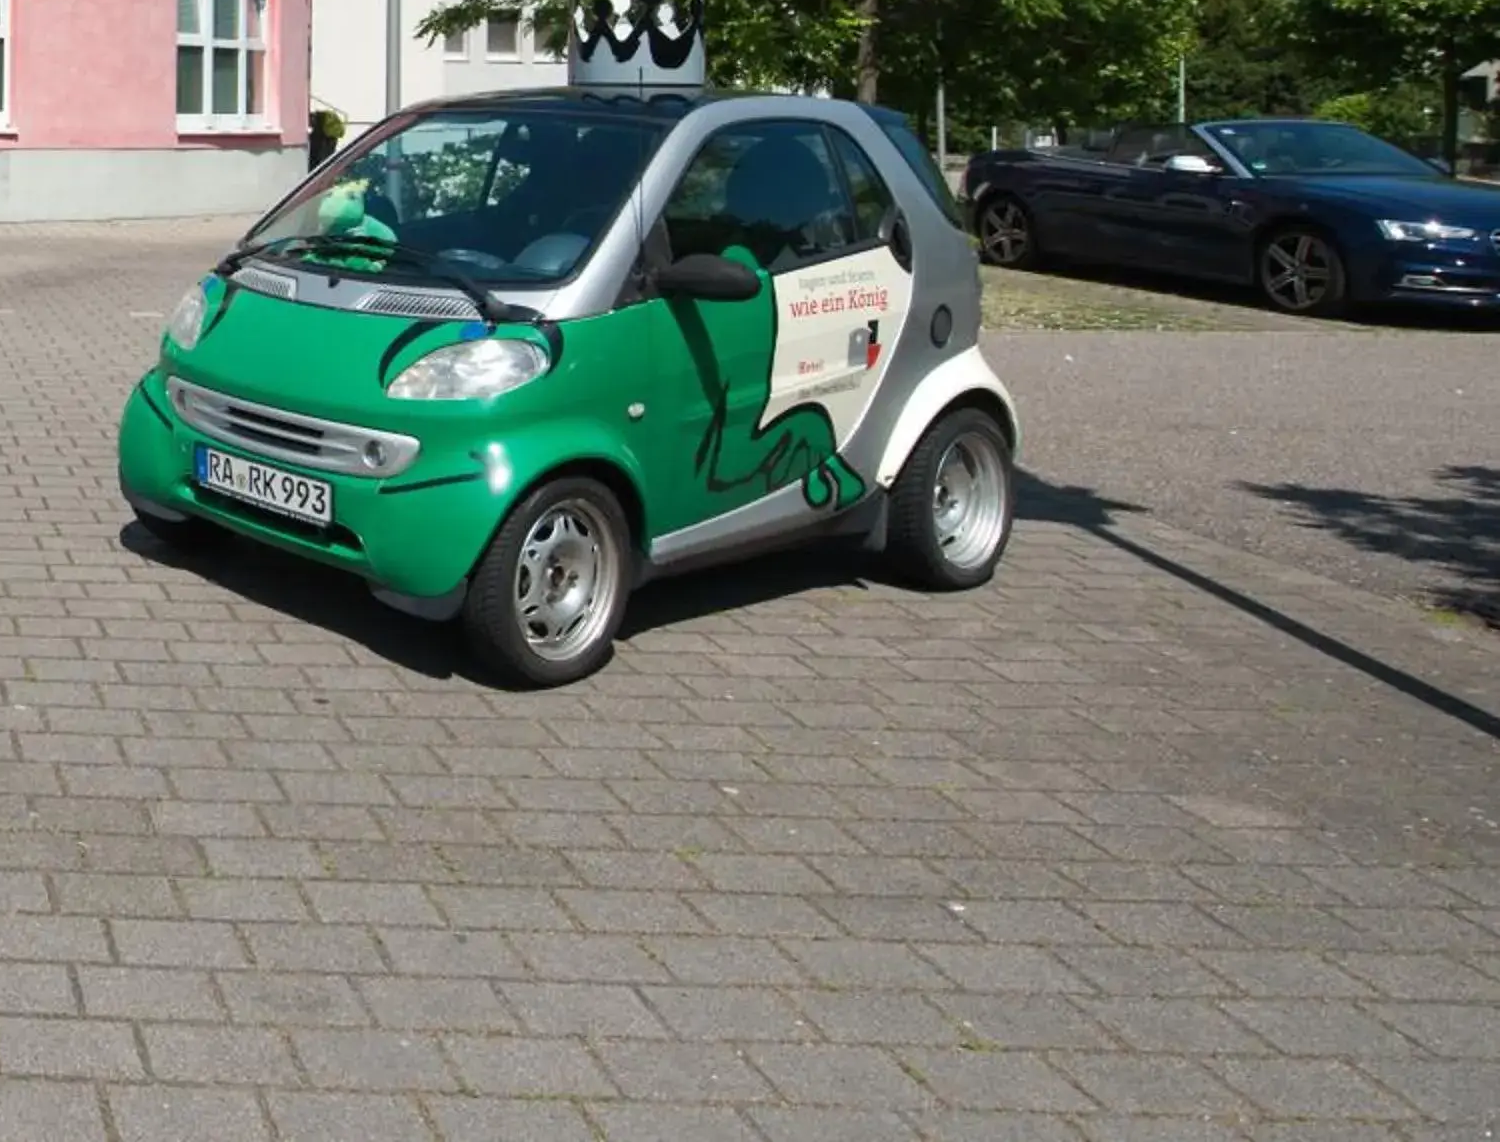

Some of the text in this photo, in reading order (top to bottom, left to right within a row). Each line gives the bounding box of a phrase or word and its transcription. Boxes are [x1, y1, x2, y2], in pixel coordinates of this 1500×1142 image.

[789, 285, 888, 317] wie ein König
[209, 453, 235, 487] RA
[248, 465, 277, 501] RK
[281, 476, 326, 515] 993
